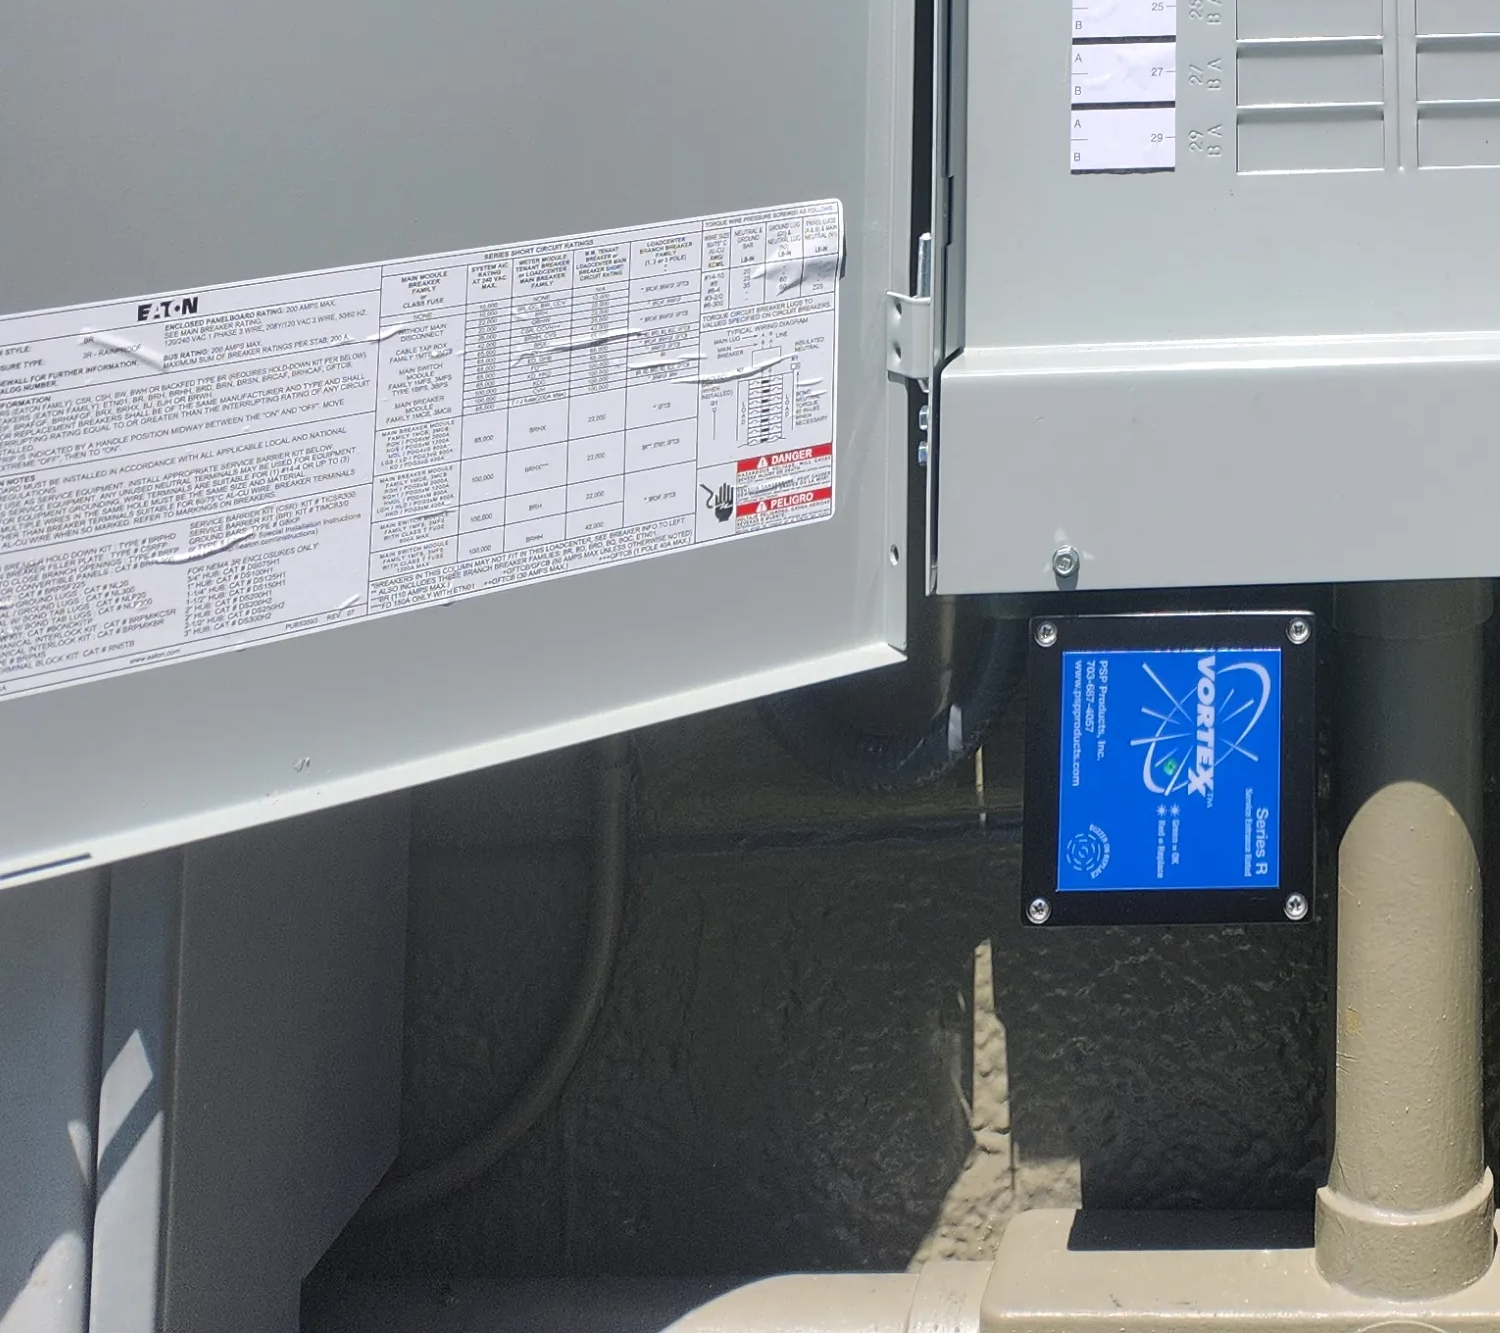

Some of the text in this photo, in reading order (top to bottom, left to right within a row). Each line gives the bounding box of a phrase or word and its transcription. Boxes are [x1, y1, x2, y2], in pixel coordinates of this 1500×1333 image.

[1152, 2, 1164, 11] 25
[1151, 67, 1164, 76] 27
[1150, 133, 1163, 142] 29
[484, 239, 594, 261] SERIES SHORT CIRCUIT RATINGS
[402, 271, 448, 283] MAIN MODULE
[408, 279, 440, 289] BREAKER
[412, 285, 436, 295] FAMILY
[402, 297, 444, 309] CLASS FUSE
[164, 319, 205, 331] ENCLOSED
[206, 311, 256, 326] PANELBOARD
[286, 305, 298, 313] 200
[298, 303, 318, 313] AMPS
[164, 323, 234, 339] SEE MAIN BREAKER
[727, 317, 808, 337] TYPICAL WIRING DIAGRAM
[83, 337, 94, 345] BR
[163, 353, 180, 361] BUS
[210, 347, 224, 355] 200
[224, 343, 244, 353] AMPS
[163, 358, 198, 369] MAXIMUM
[198, 355, 216, 364] SUM
[228, 347, 260, 358] BREAKER
[262, 343, 293, 354] RATINGS
[294, 339, 308, 349] PER
[30, 368, 84, 383] FOR FURTHER
[264, 427, 347, 449] LOCAL NATIONAL
[771, 449, 813, 465] DANGER
[770, 493, 814, 509] PELIGRO
[326, 613, 340, 621] REV
[1099, 660, 1108, 683] PSP
[1085, 659, 1096, 733] 703-687-4057
[1072, 660, 1082, 787] www.pspproducts.com
[1188, 655, 1216, 797] VORTEX
[1097, 741, 1106, 761] Inc.
[1256, 808, 1269, 875] Series R
